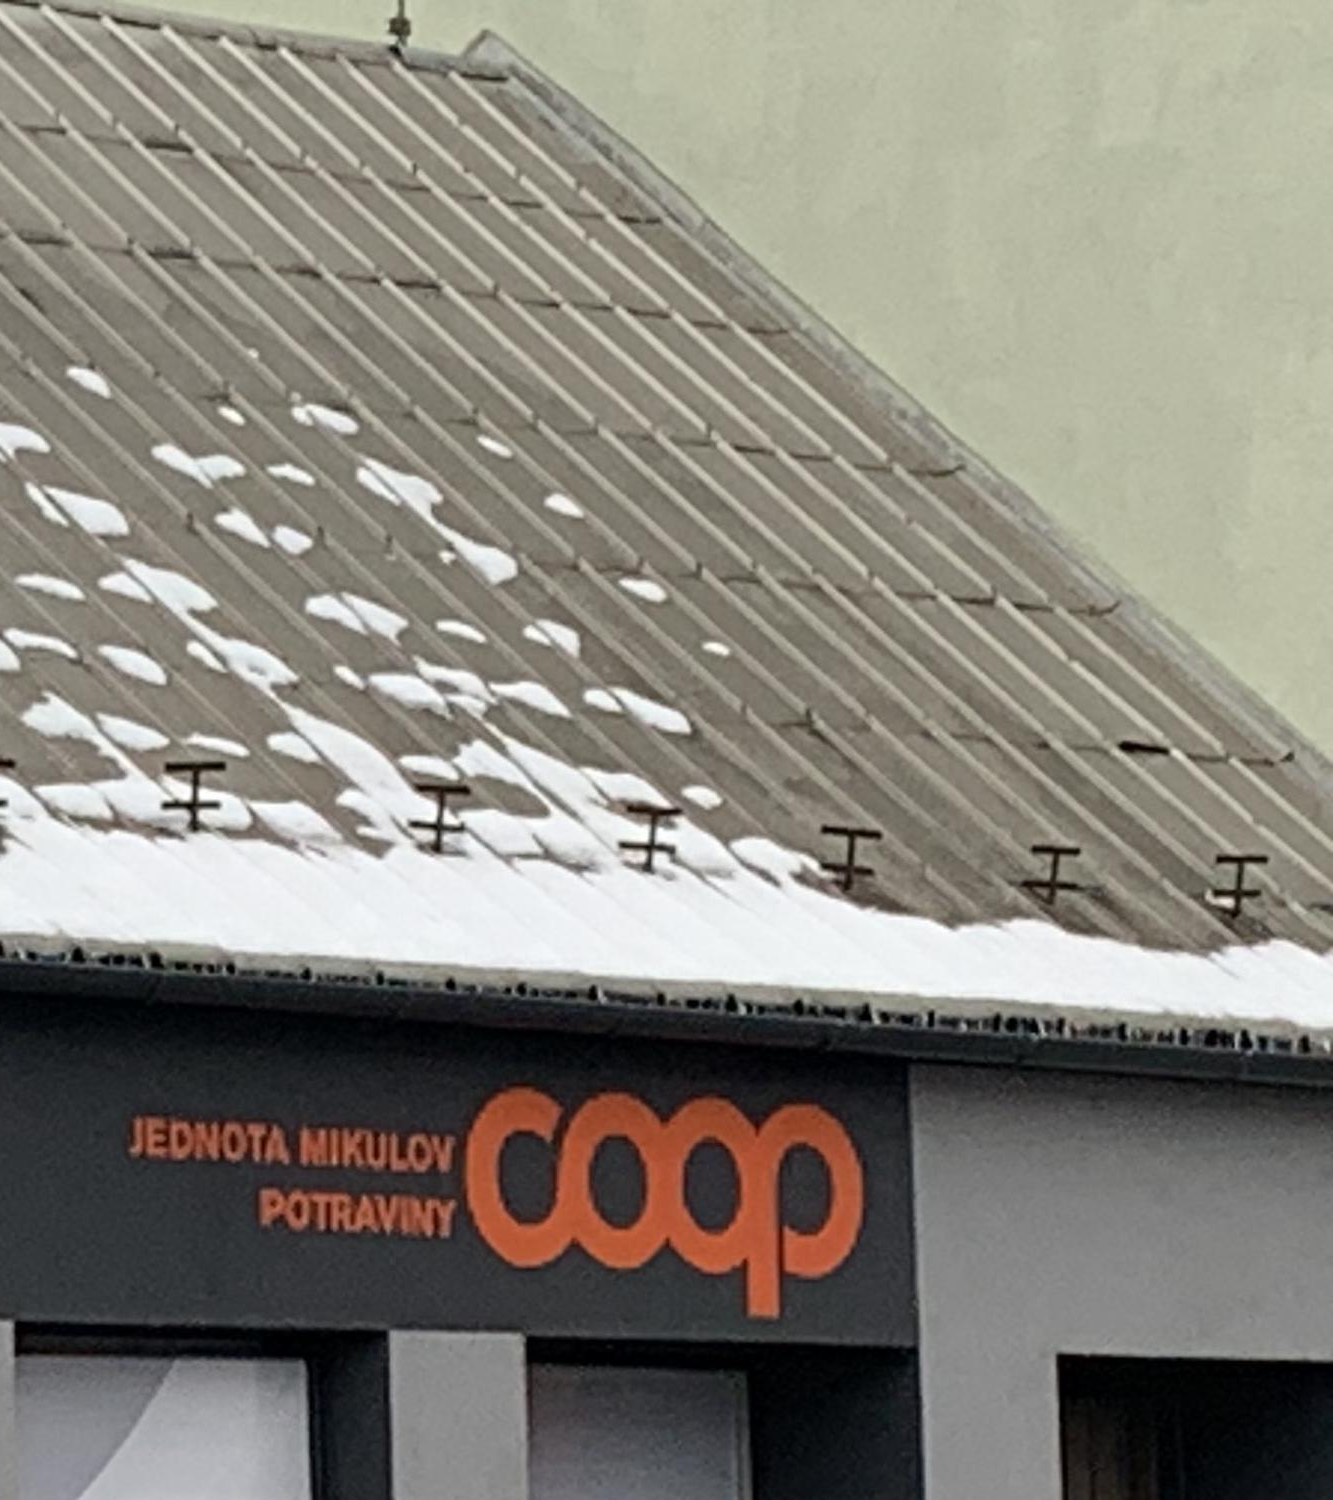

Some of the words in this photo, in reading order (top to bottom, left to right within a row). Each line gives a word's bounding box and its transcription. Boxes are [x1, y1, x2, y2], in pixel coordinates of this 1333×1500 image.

[129, 1116, 290, 1164] JEDNOTA
[299, 1125, 455, 1173] MIKULOV
[258, 1188, 456, 1238] POTRAVINY
